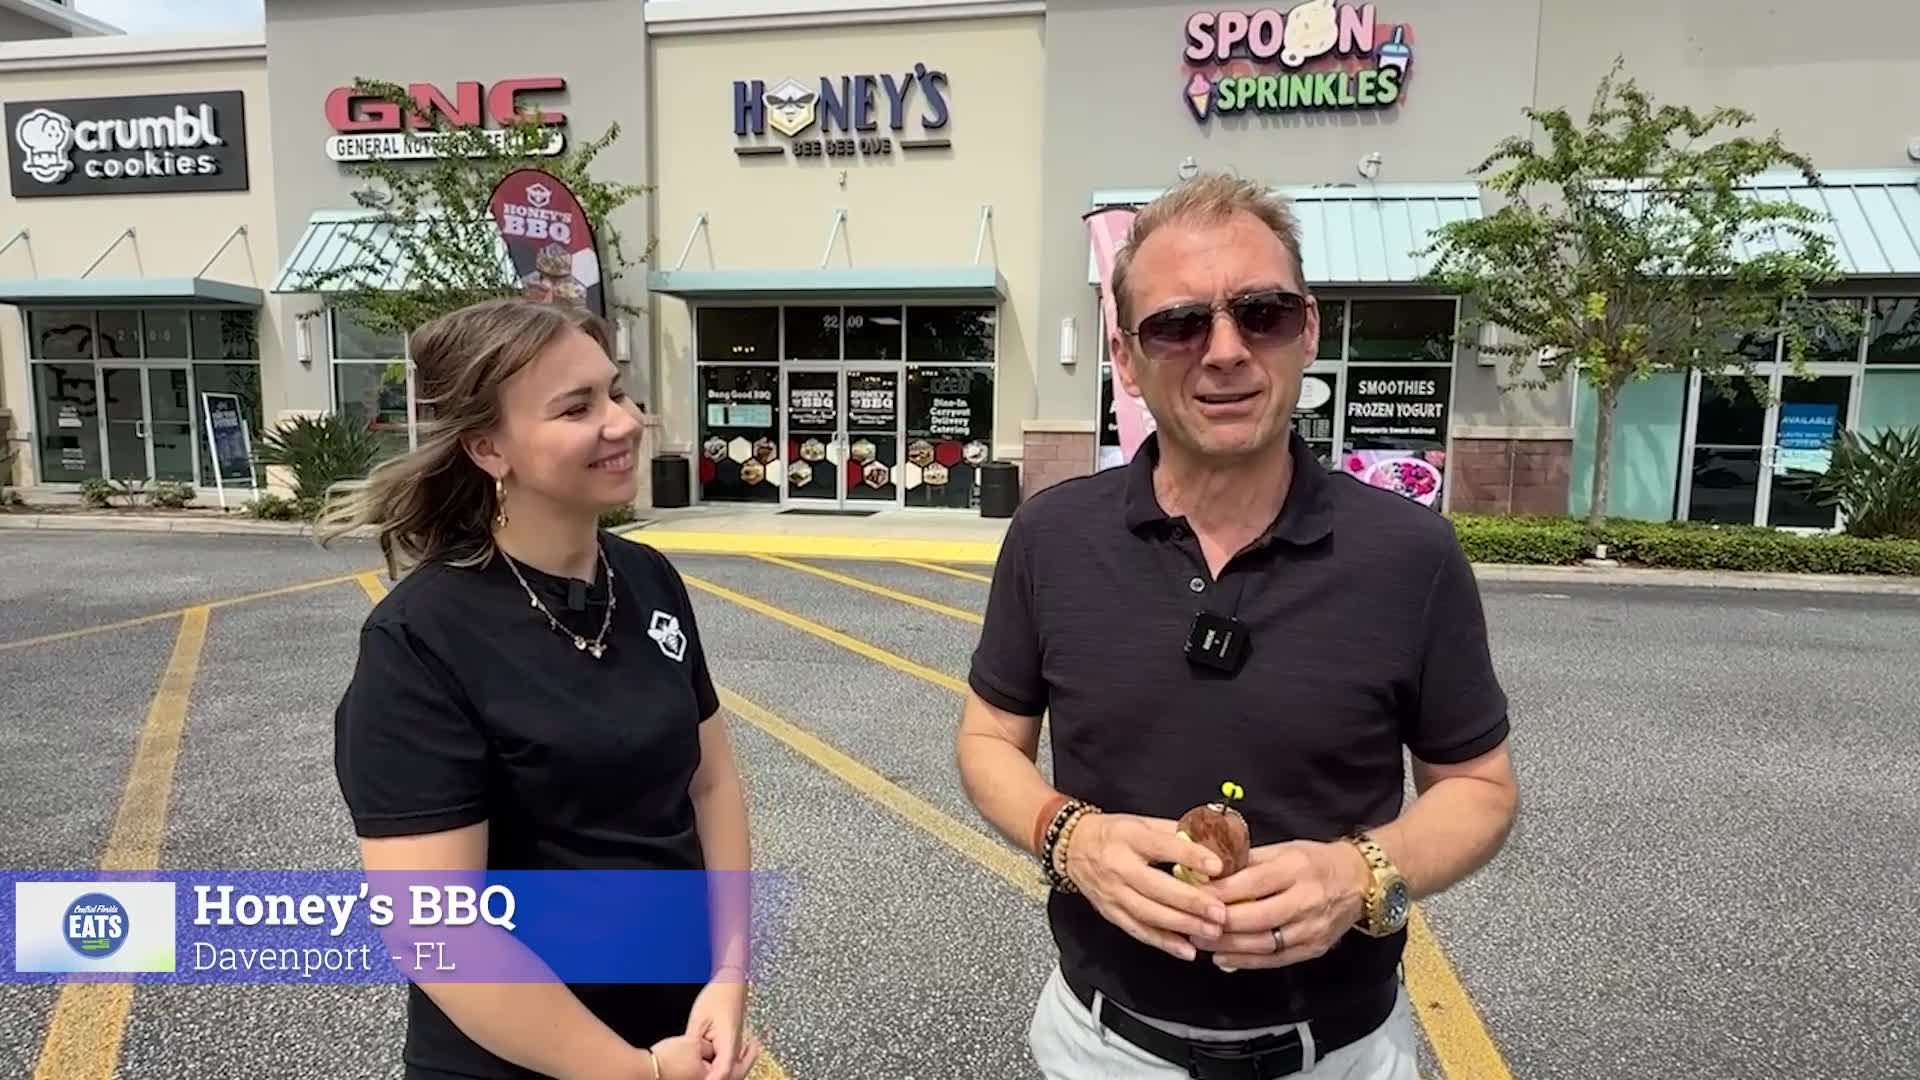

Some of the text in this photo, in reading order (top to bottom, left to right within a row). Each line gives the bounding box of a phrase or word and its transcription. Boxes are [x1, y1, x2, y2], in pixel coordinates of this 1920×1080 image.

[1217, 68, 1401, 111] SPRINKLES
[325, 78, 567, 134] GNC
[75, 103, 224, 151] crumbl
[336, 137, 399, 157] GENERAL
[793, 137, 891, 156] BEE BEE QUE
[85, 150, 217, 178] cookies
[503, 203, 572, 223] HONEY'S
[503, 214, 571, 244] BBQ
[708, 389, 772, 400] Dang Good BBQ
[1358, 380, 1436, 395] SMOOTHIES
[802, 398, 834, 408] BBQ
[861, 398, 894, 409] BBQ
[1348, 402, 1443, 418] FROZEN YOGURT
[931, 416, 970, 427] Delivery
[1781, 416, 1833, 425] AVAILABLE
[930, 425, 970, 436] Catering
